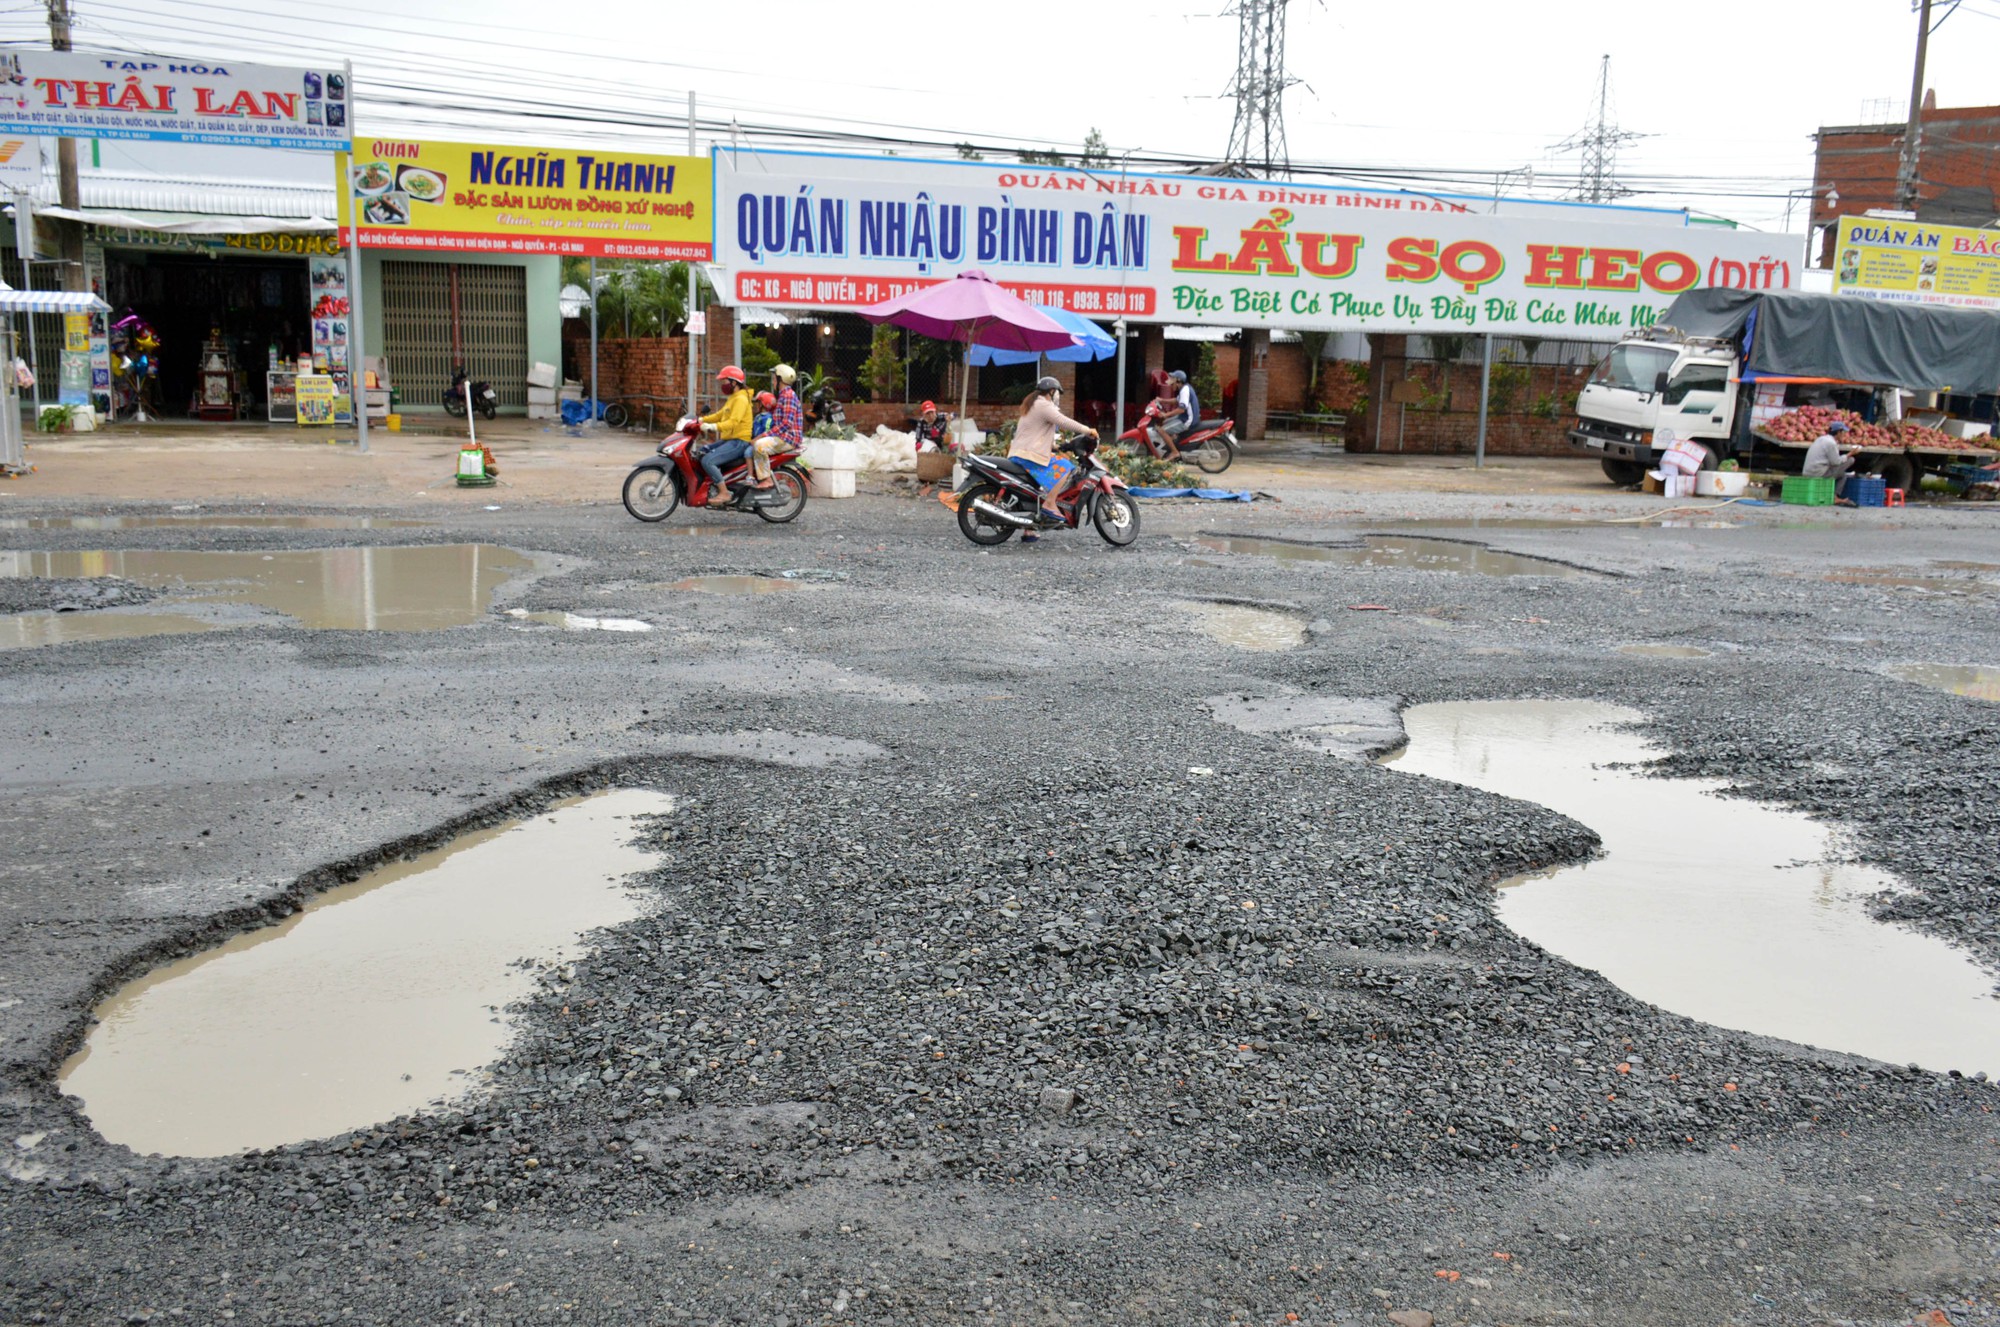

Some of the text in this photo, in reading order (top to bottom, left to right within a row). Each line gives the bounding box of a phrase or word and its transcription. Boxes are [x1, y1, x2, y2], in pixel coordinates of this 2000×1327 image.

[100, 60, 158, 73] TẠP
[34, 76, 301, 120] THÁI LAN
[271, 125, 285, 134] KEM
[470, 151, 676, 194] NGHĨA THANH
[998, 172, 1086, 191] QUÁN
[1197, 186, 1247, 201] GIA
[453, 190, 487, 210] ĐẶC
[528, 195, 572, 211] LƯƠN
[576, 195, 622, 214] ĐỒNG
[625, 199, 649, 215] XỨ
[652, 200, 695, 220] NGHỆ
[737, 185, 1150, 276] QUÁN NHẬU BÌNH DÂN
[1850, 225, 1941, 248] QUÁN ĂN
[1172, 207, 1364, 279] LẨU
[1385, 237, 1506, 294] SỌ
[1523, 242, 1702, 296] HEO
[741, 278, 761, 298] ĐC:
[764, 279, 780, 299] K6
[790, 277, 813, 300] NGÔ
[817, 276, 856, 303] QUYỀN
[866, 282, 879, 302] P1
[1048, 290, 1064, 308] 116
[1073, 292, 1102, 310] 0938.
[1106, 292, 1126, 311] 580
[1129, 293, 1145, 312] 116
[1172, 285, 1224, 317] Đặc
[1230, 288, 1282, 319] Biệt
[1290, 290, 1322, 315] Có
[1329, 291, 1385, 323] Phục
[1393, 294, 1423, 325] Vụ
[1431, 295, 1477, 326] Đầy
[1485, 298, 1518, 321] Đủ
[1526, 299, 1567, 323] Các
[1574, 301, 1622, 326] Món
